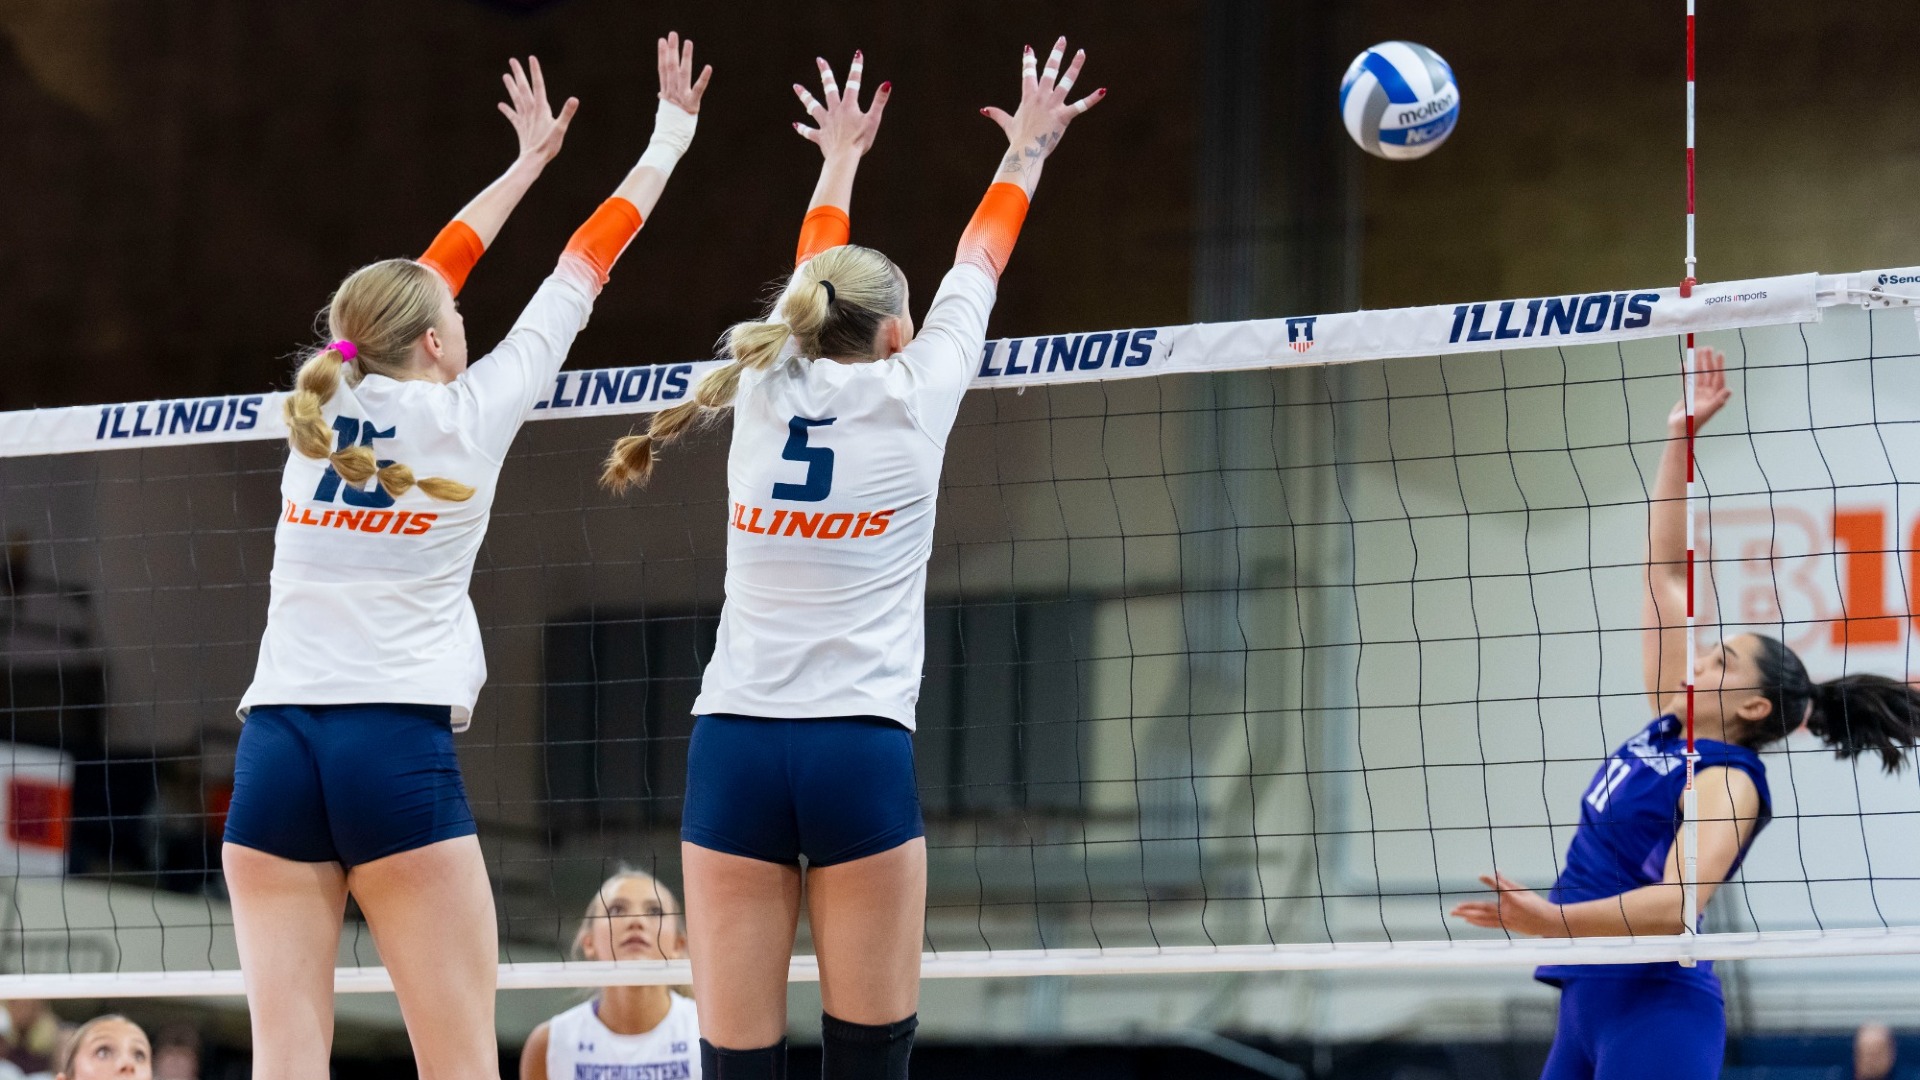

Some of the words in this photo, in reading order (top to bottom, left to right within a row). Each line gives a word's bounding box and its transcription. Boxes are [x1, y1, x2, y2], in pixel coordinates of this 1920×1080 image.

[1398, 94, 1452, 125] molten
[1449, 293, 1660, 343] ILLINOIS
[1704, 293, 1732, 306] sports
[1733, 289, 1767, 302] imports
[978, 329, 1158, 377] LLINOIS
[533, 365, 693, 409] LINOIS
[96, 396, 263, 440] ILLINOIS
[772, 415, 837, 502] 5
[283, 499, 438, 536] ILLINOIS
[731, 502, 896, 539] ILLINOIS
[1692, 506, 1920, 652] B1
[1586, 755, 1631, 813] 11
